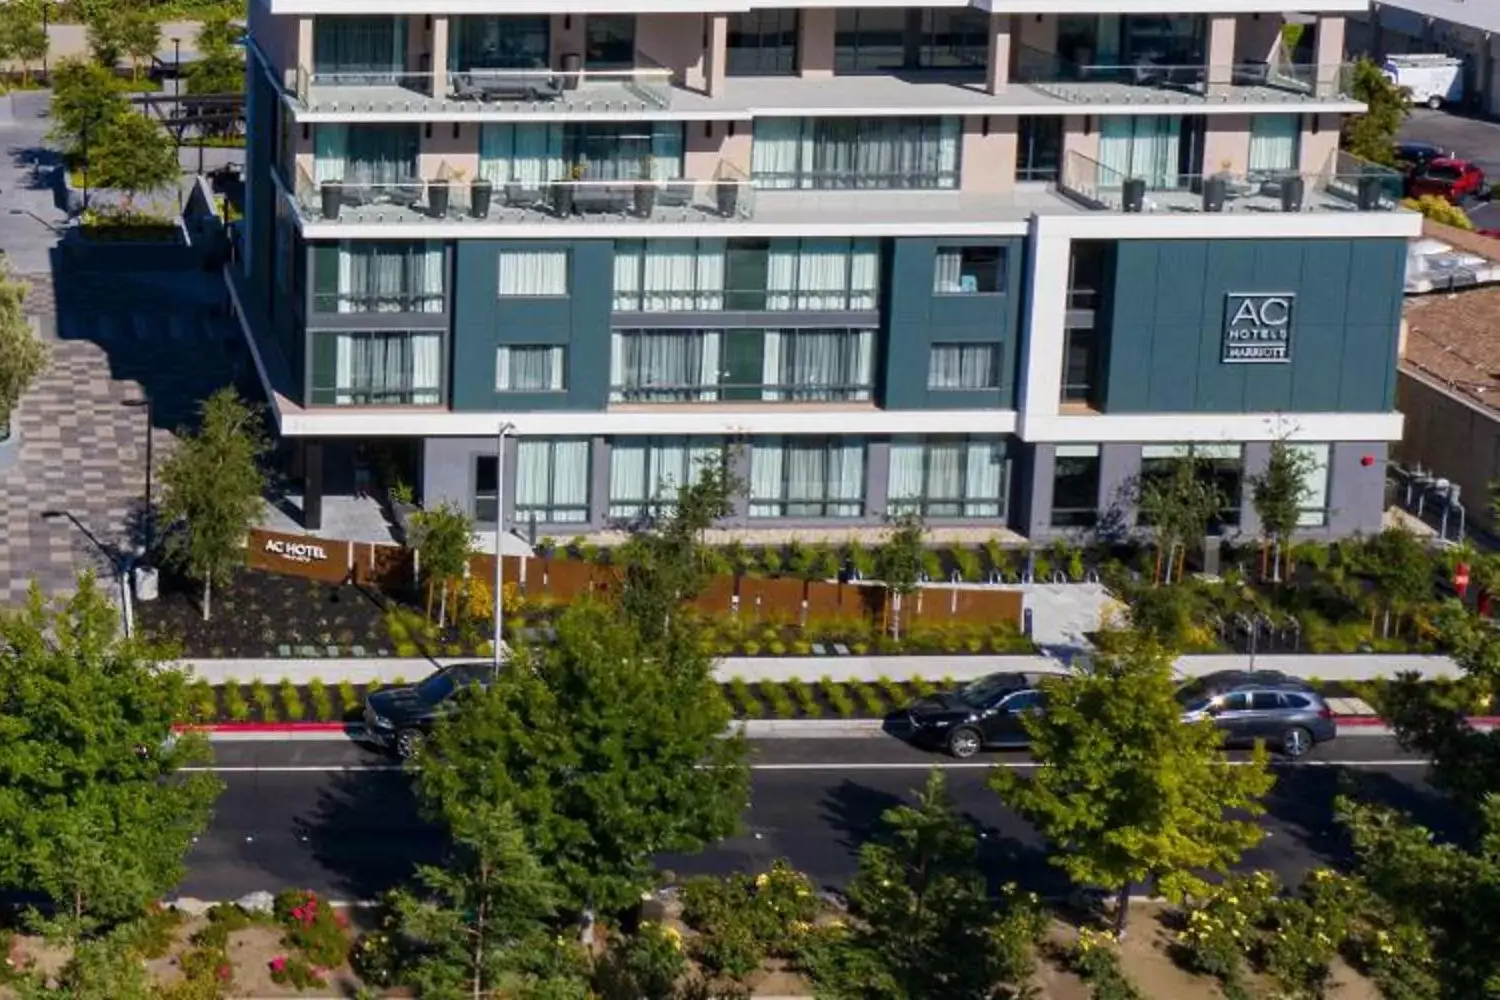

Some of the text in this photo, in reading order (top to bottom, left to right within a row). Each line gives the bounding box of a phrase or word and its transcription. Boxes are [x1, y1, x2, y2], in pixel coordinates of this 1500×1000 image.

[1231, 297, 1288, 326] AC
[1229, 328, 1287, 340] HOTELS
[1229, 347, 1286, 357] MARRIOTT
[265, 540, 284, 553] AC
[285, 542, 328, 559] HOTEL
